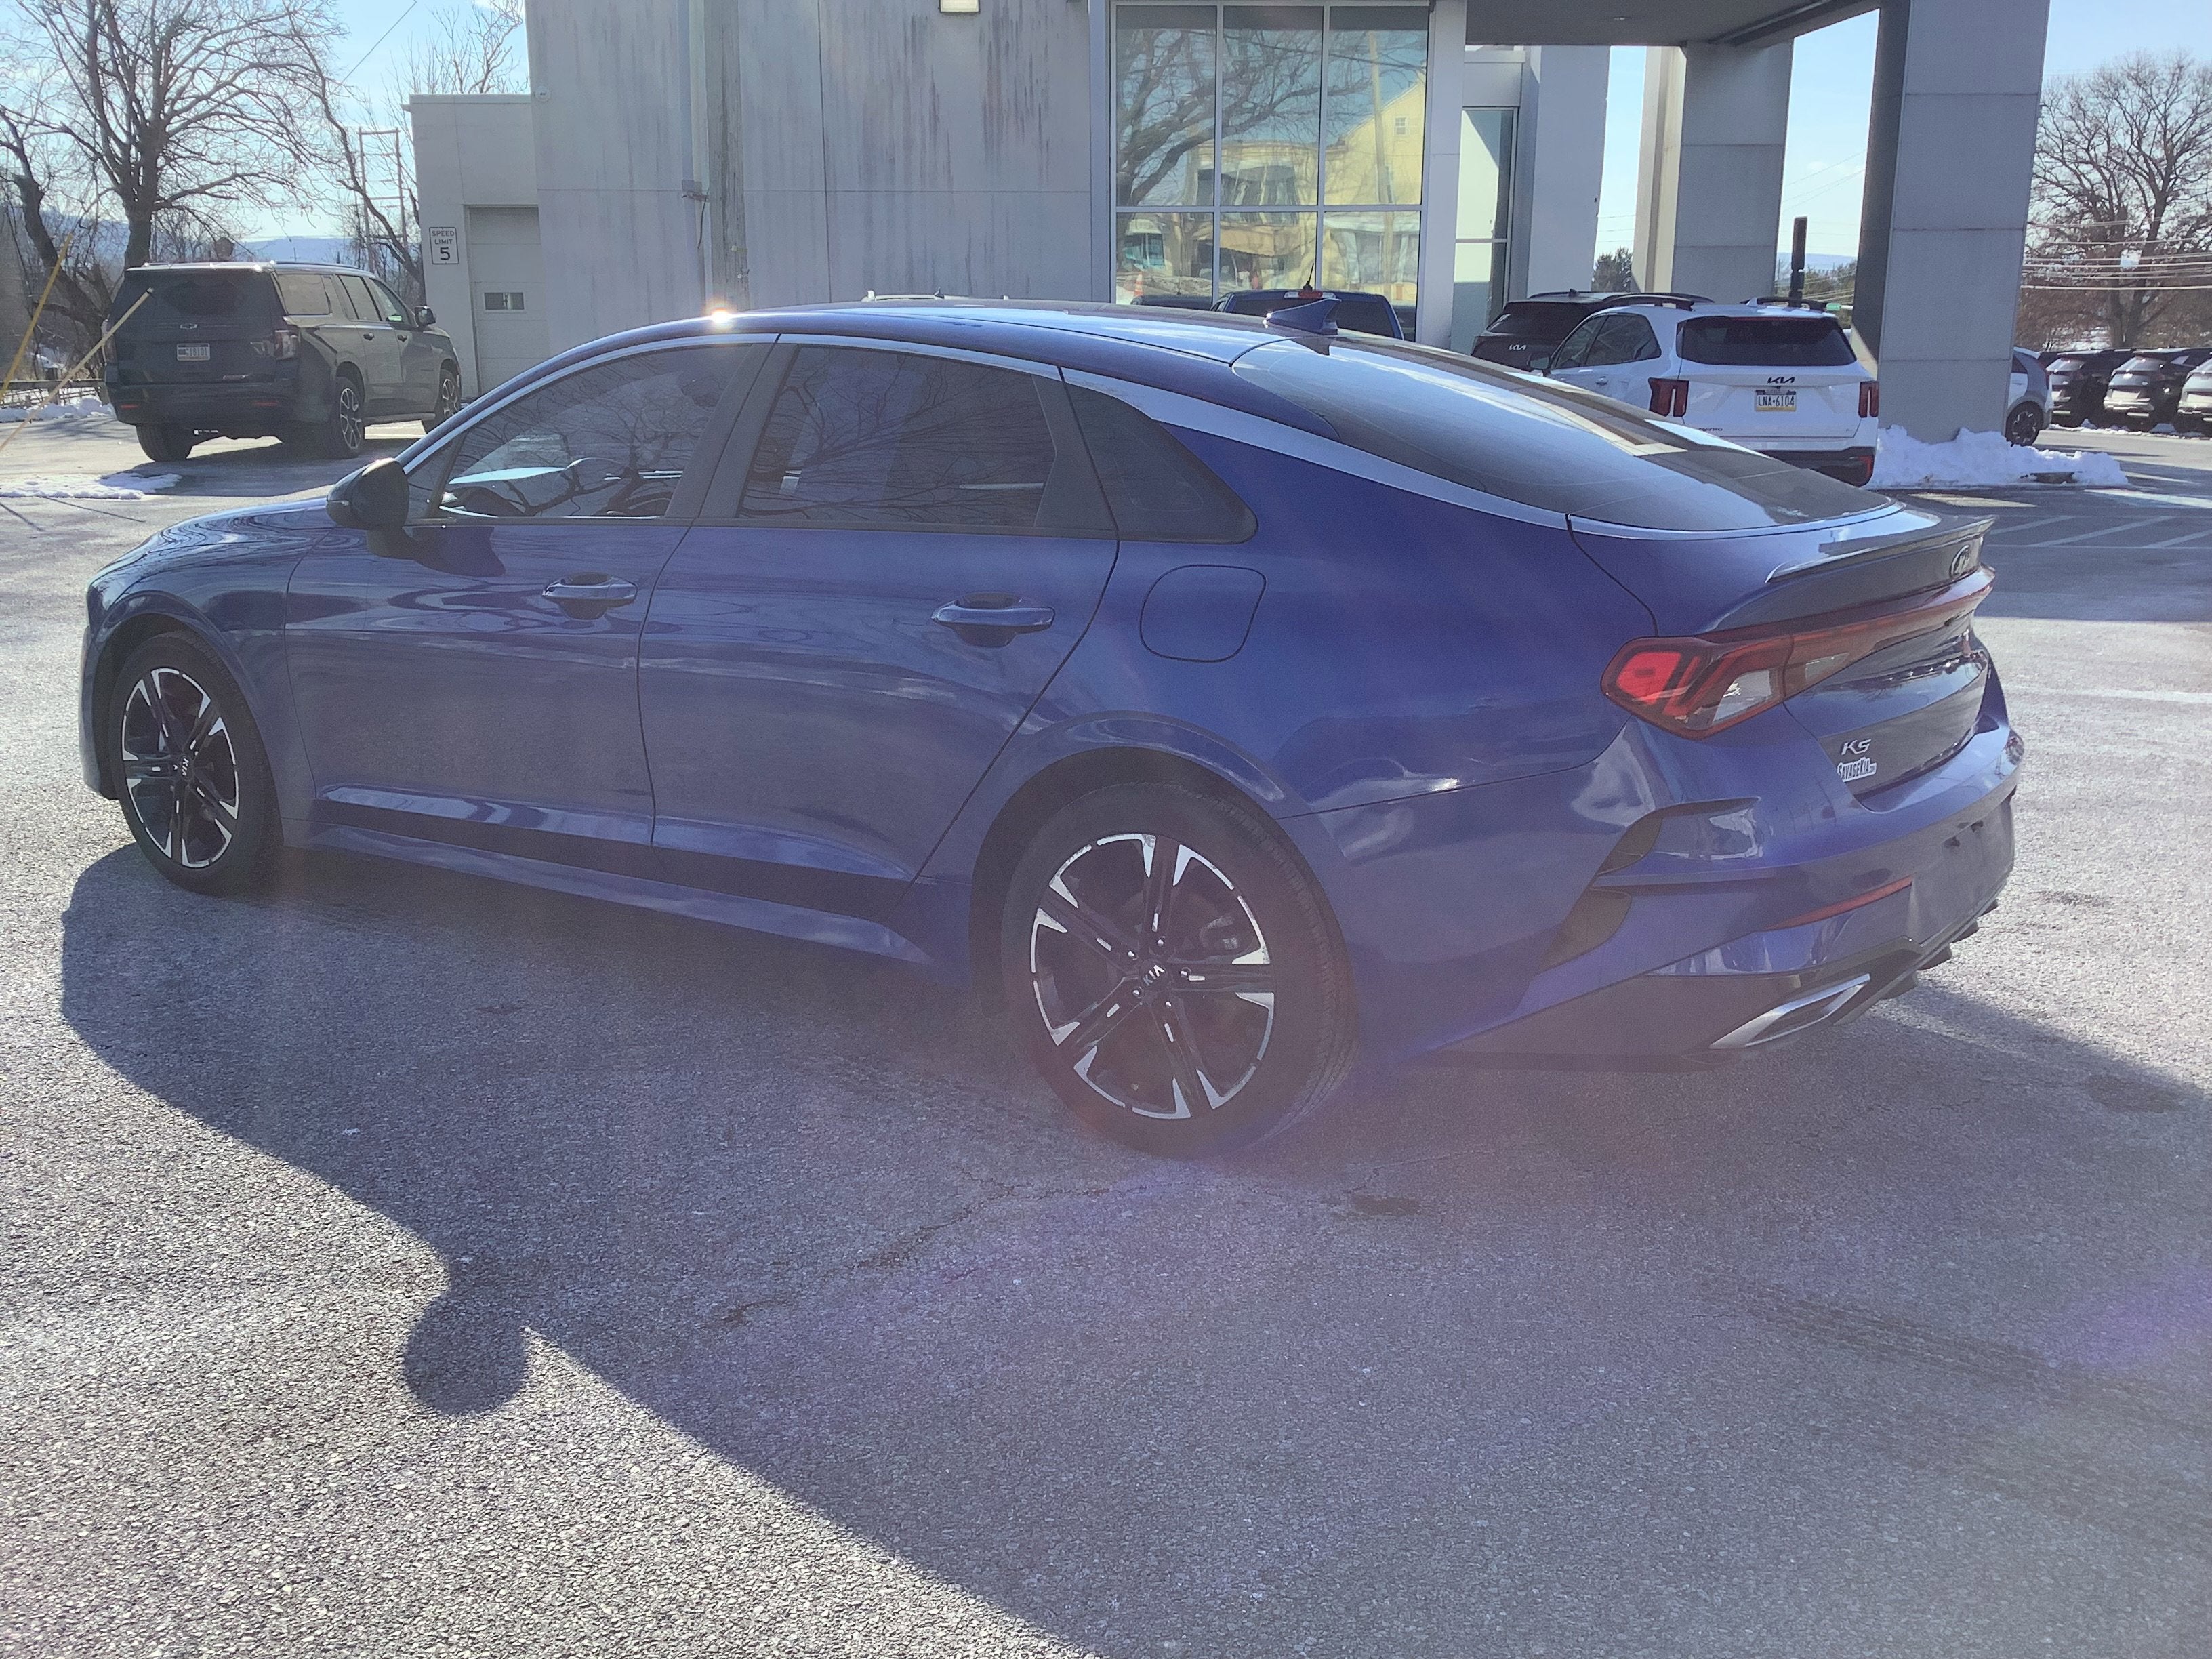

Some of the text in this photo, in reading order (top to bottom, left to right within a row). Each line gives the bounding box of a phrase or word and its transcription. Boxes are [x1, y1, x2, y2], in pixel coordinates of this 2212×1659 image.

[440, 247, 451, 261] 5
[1841, 739, 1872, 756] K5
[1143, 964, 1165, 986] KIA
